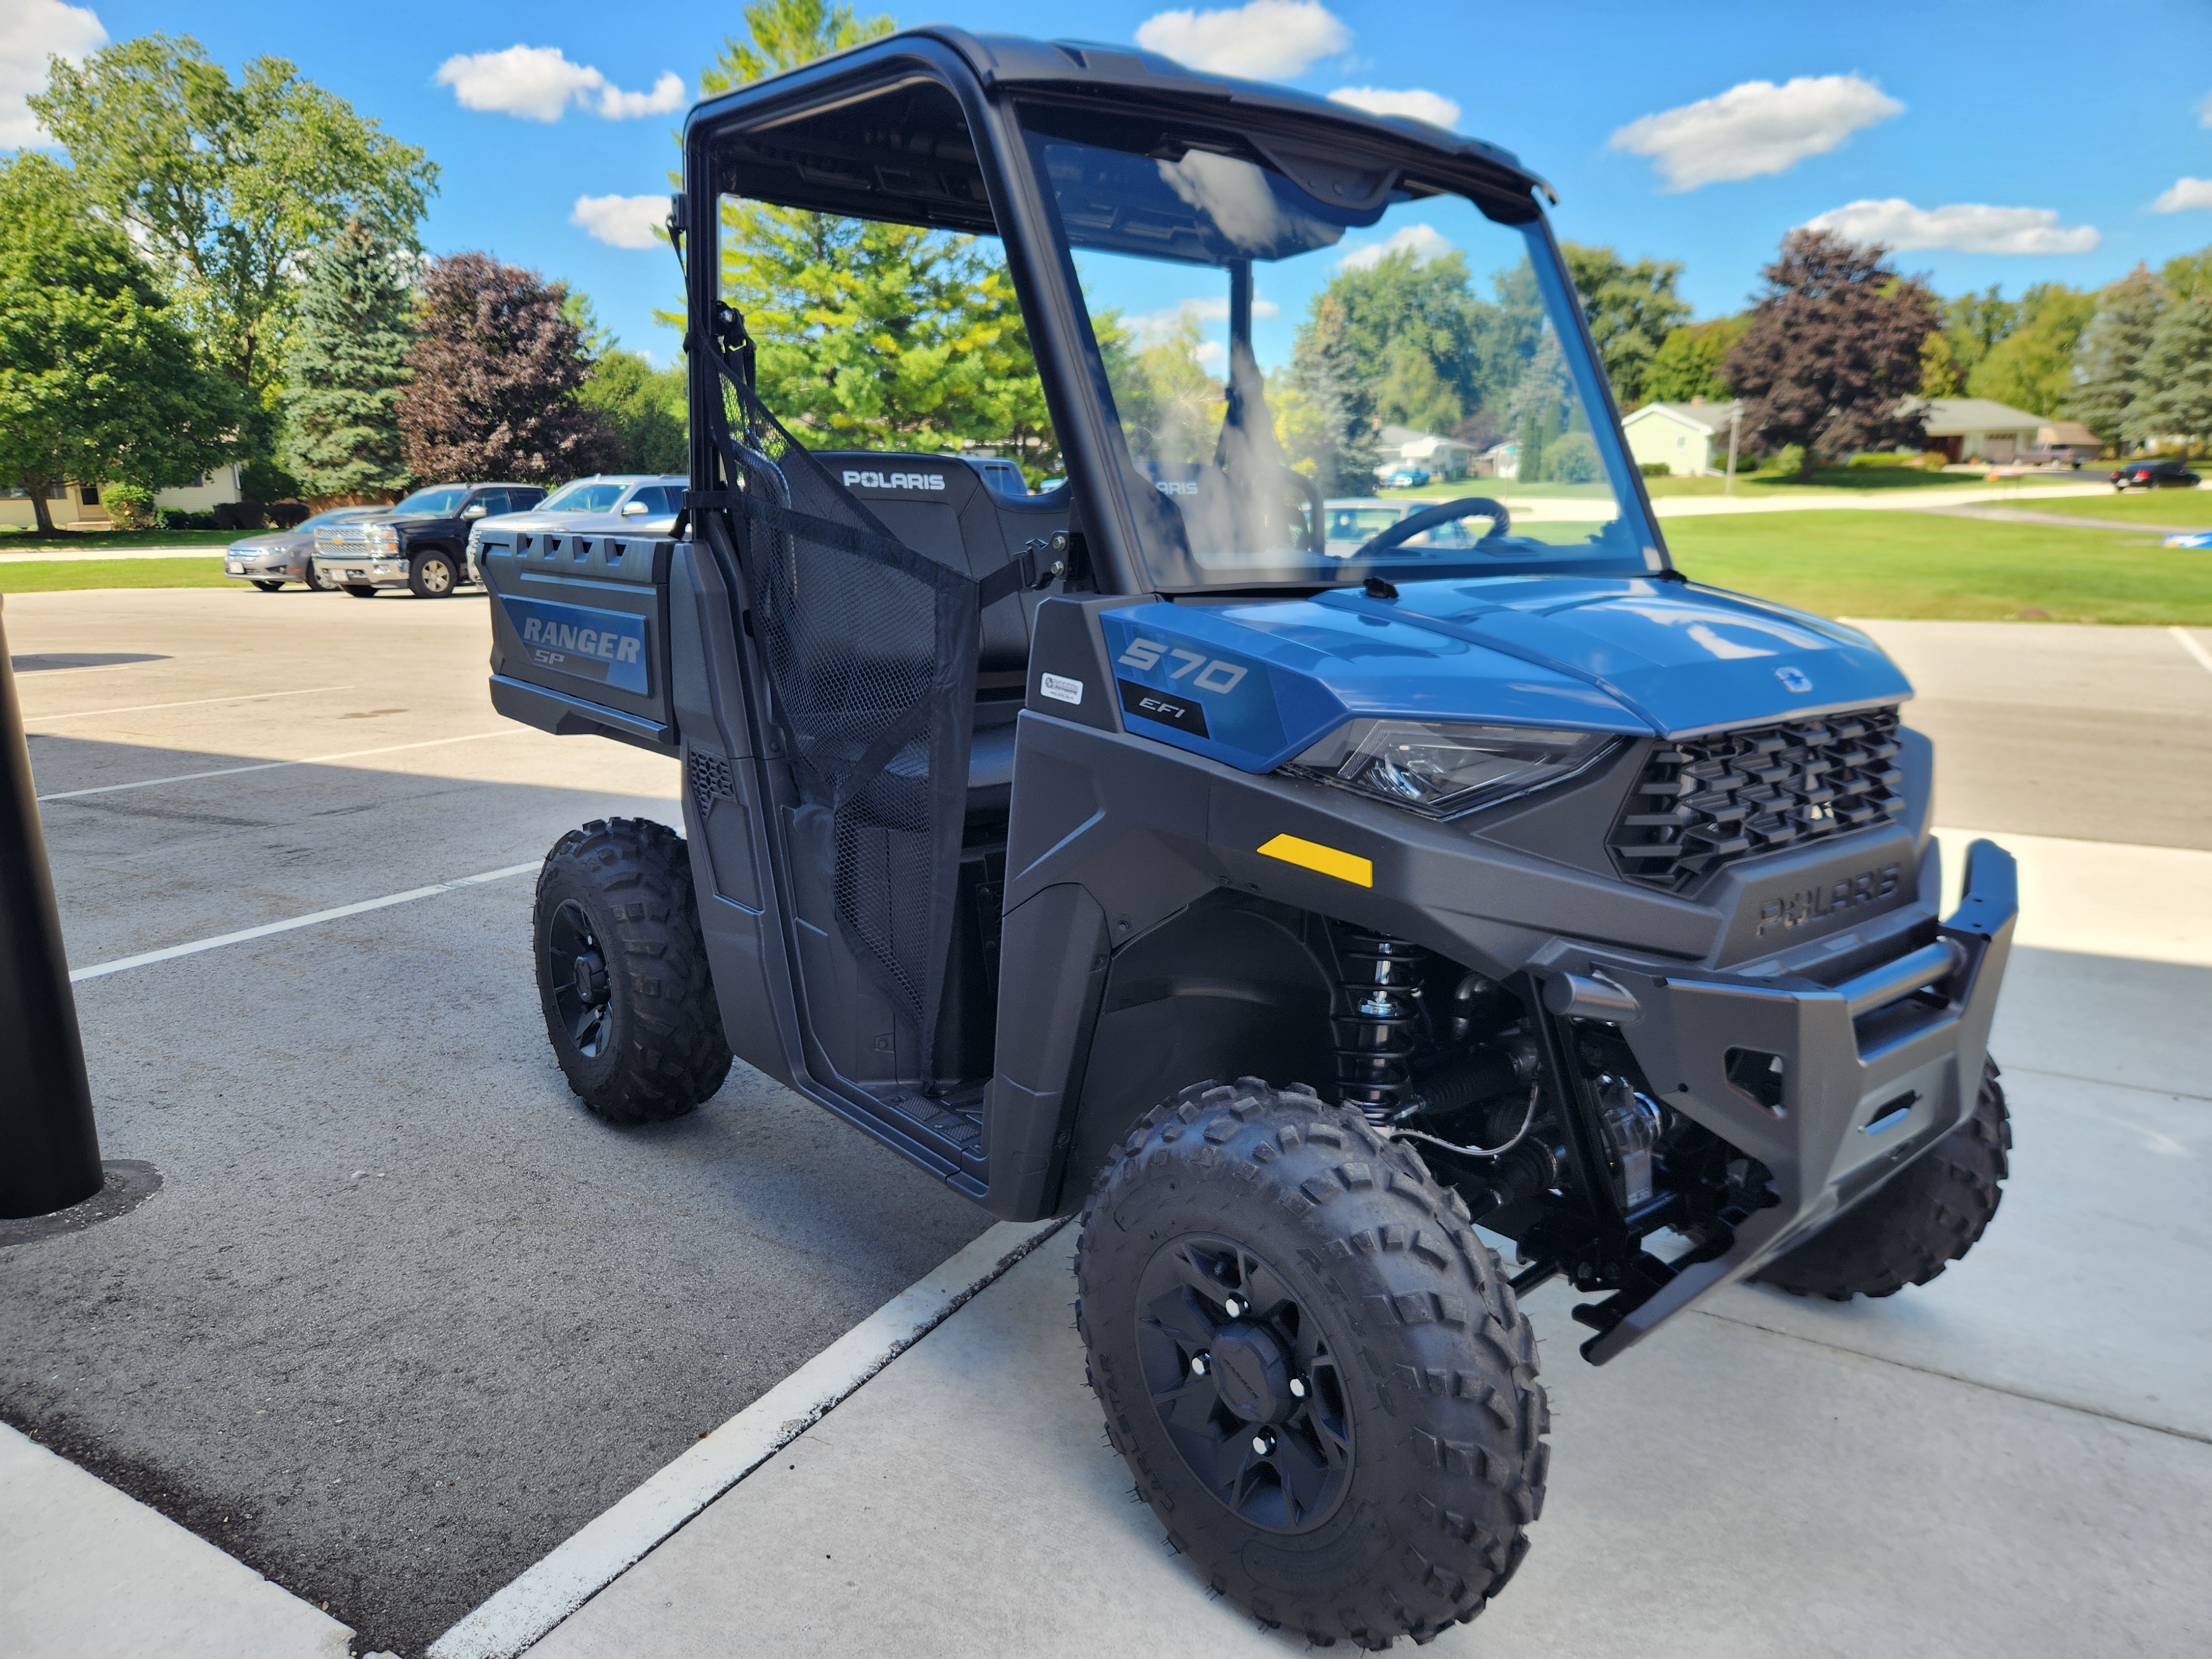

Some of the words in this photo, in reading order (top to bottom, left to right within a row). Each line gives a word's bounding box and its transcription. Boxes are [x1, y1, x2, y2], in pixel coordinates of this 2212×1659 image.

[842, 471, 946, 490] POLARIS
[1156, 482, 1199, 495] ARIS
[523, 617, 640, 664] RANGER
[535, 649, 565, 664] SP
[1117, 637, 1249, 694] 570
[1139, 697, 1186, 718] EFI
[1755, 862, 1900, 938] POLARIS
